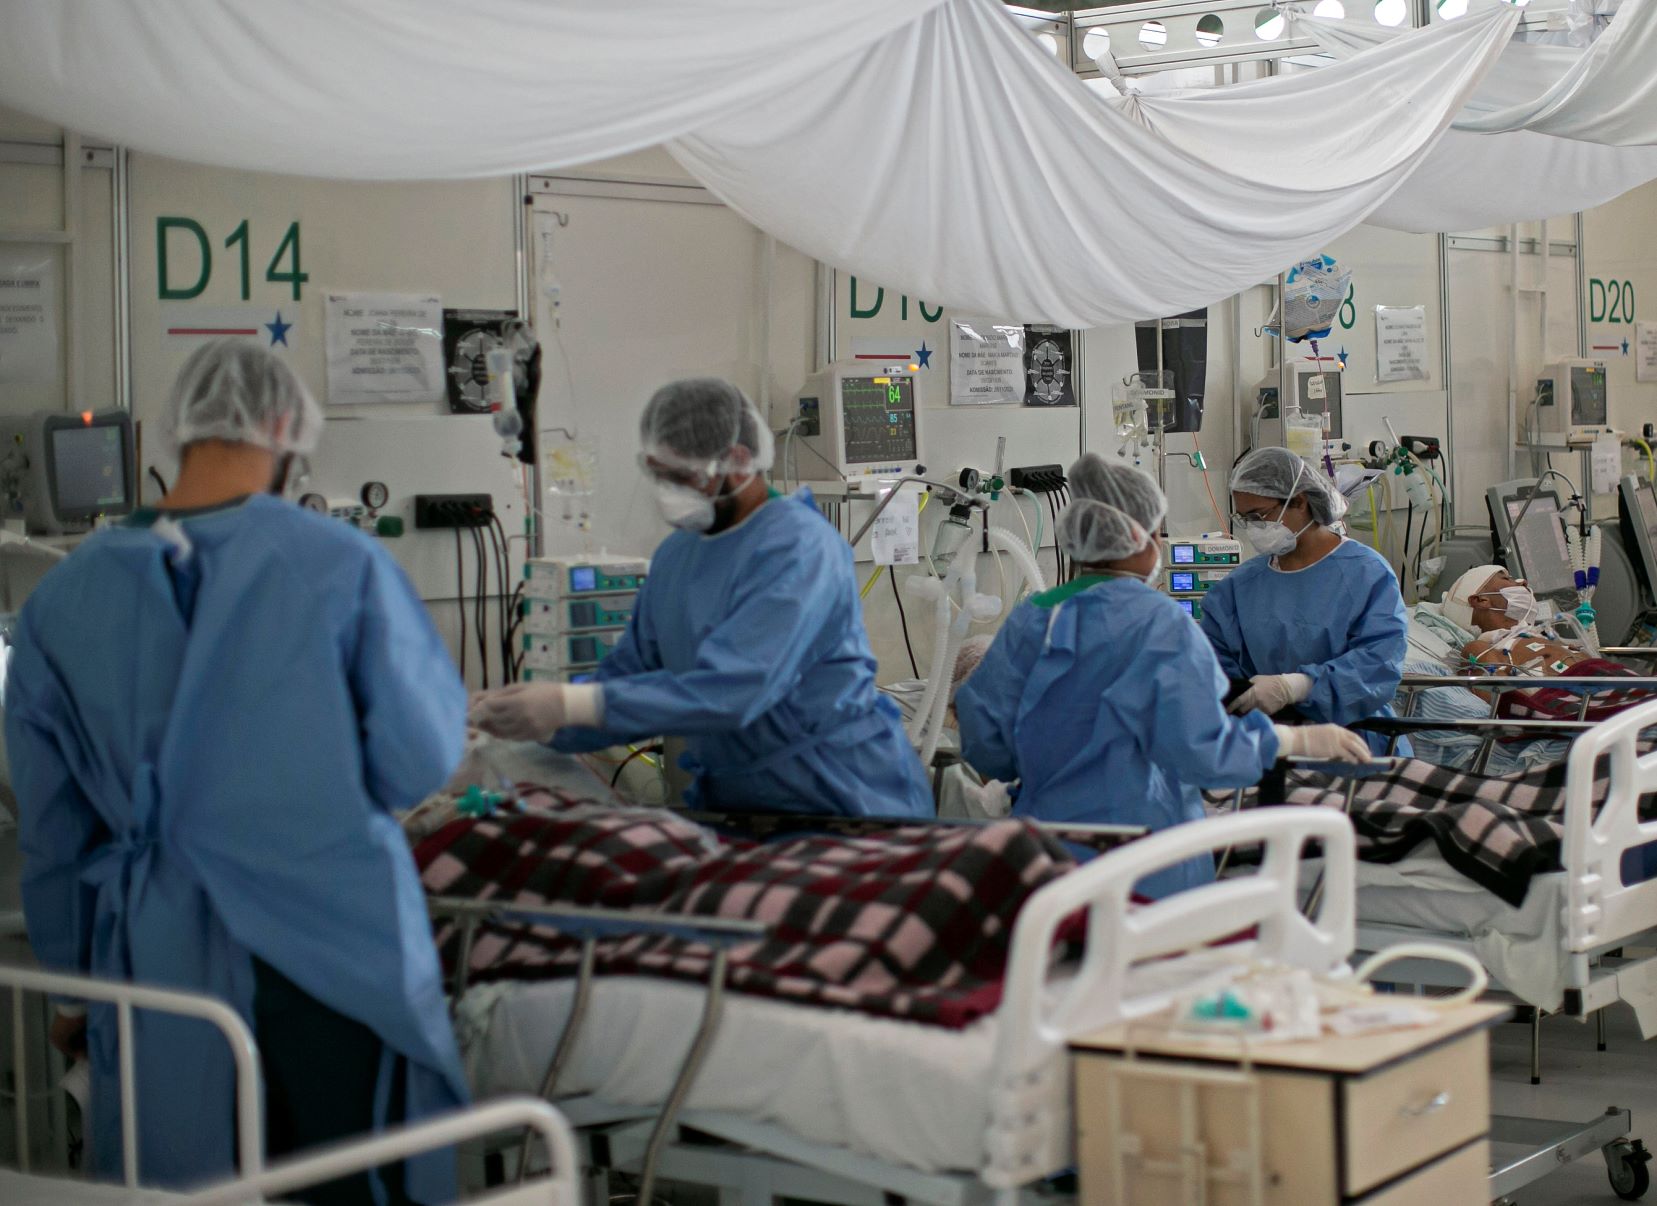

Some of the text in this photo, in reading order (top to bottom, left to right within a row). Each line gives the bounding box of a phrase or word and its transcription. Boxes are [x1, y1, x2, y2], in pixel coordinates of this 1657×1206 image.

[157, 216, 310, 301] D14
[1590, 278, 1635, 324] D20
[888, 384, 901, 404] 64
